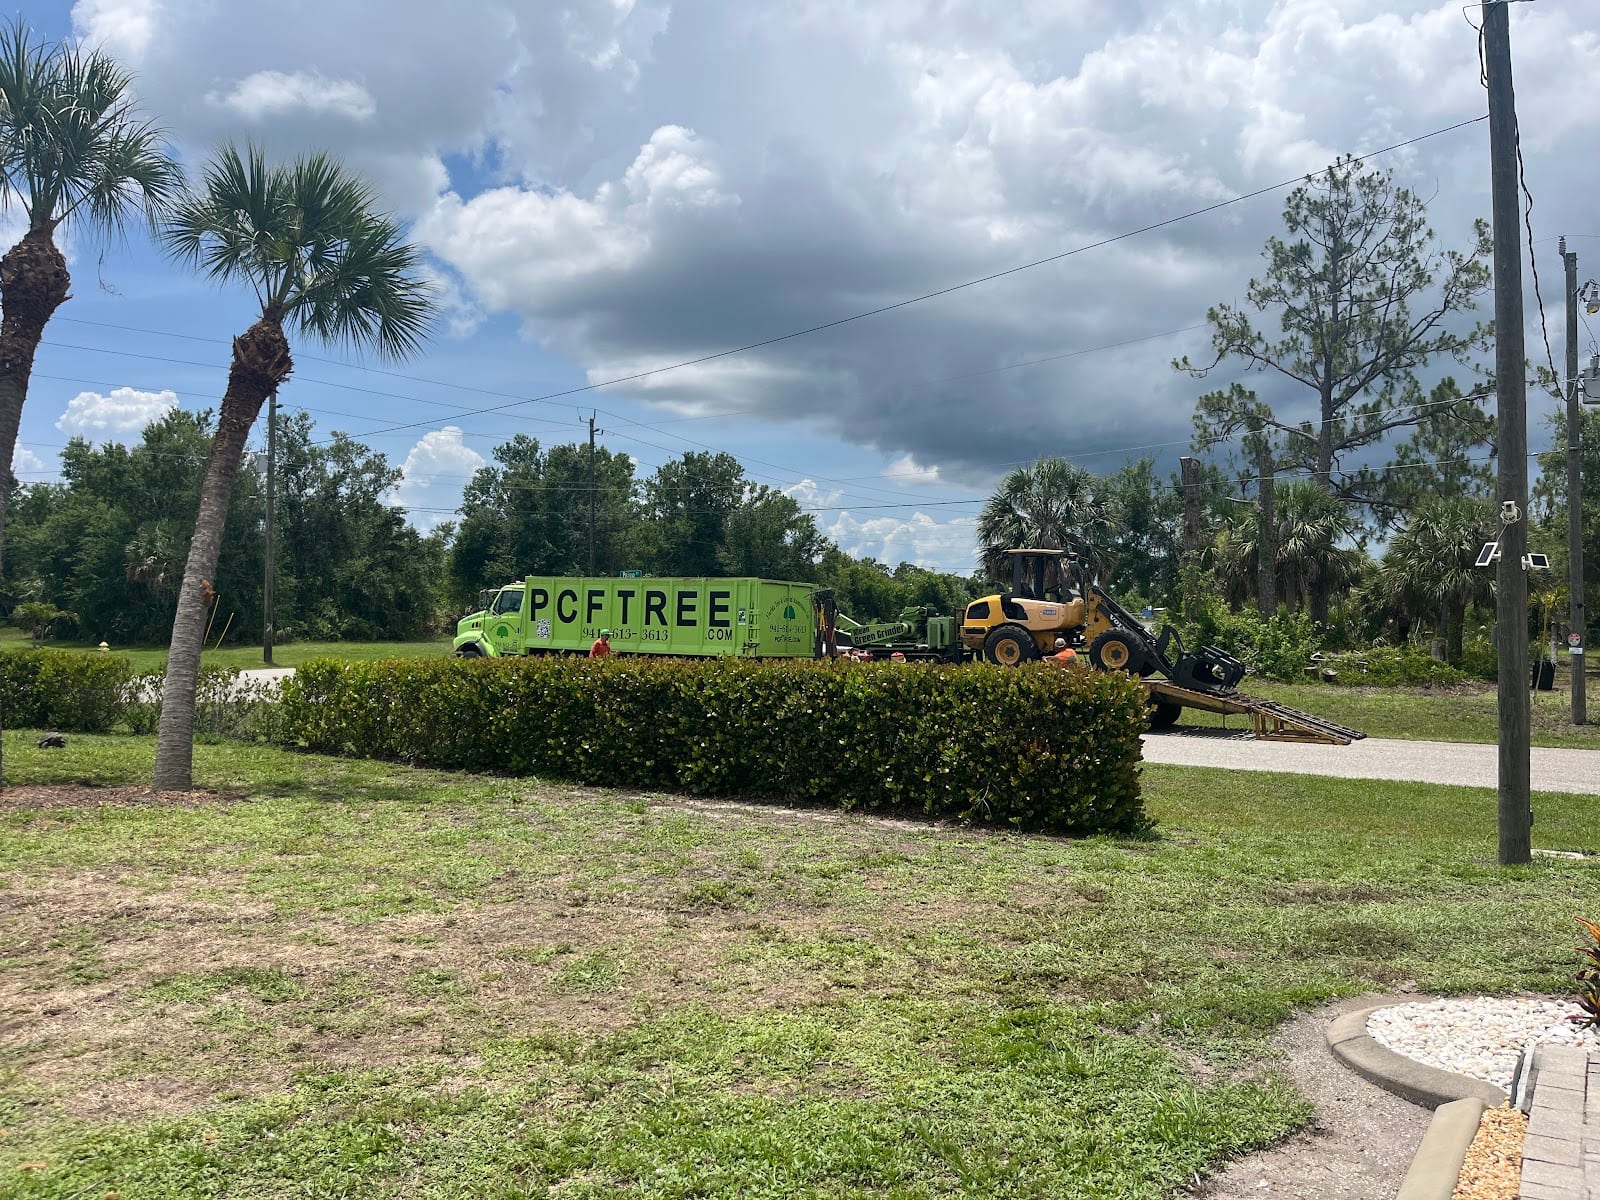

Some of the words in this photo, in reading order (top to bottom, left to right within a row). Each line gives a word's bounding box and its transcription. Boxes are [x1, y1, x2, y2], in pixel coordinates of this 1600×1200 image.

[582, 628, 669, 641] 941613-3613
[854, 633, 876, 645] Green
[876, 624, 904, 639] Grinder
